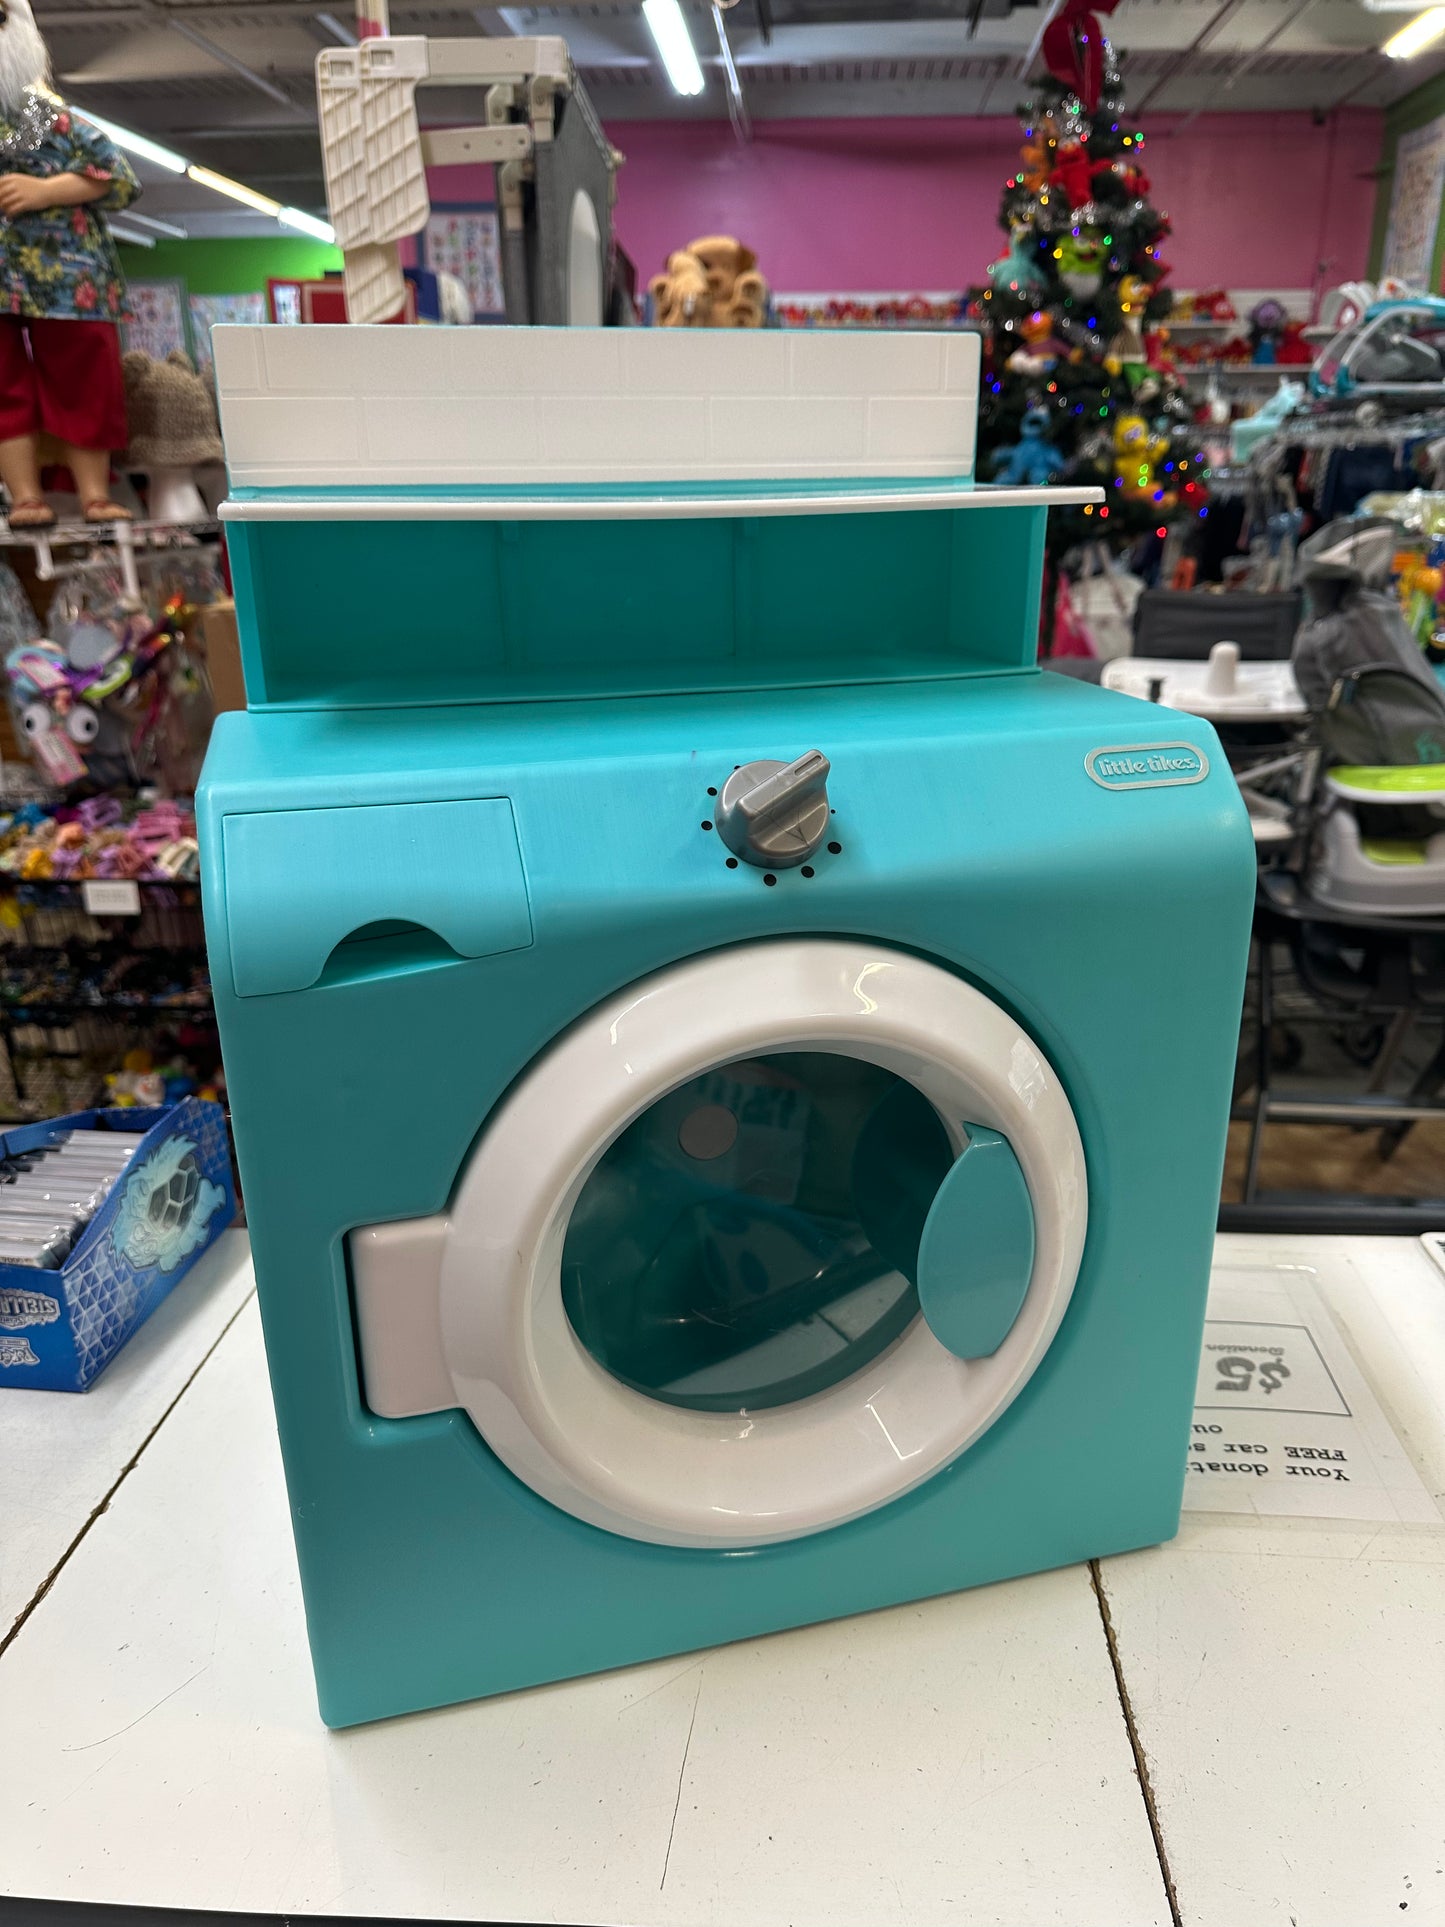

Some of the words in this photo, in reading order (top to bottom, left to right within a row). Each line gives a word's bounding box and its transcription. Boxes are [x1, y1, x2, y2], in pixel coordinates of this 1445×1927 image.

[1098, 759, 1147, 776] little
[1205, 1344, 1285, 1356] Donation
[1215, 1356, 1291, 1394] $5
[1190, 1424, 1223, 1435] ou
[1224, 1443, 1268, 1454] car
[1284, 1446, 1348, 1461] FREE
[1285, 1465, 1351, 1482] Your
